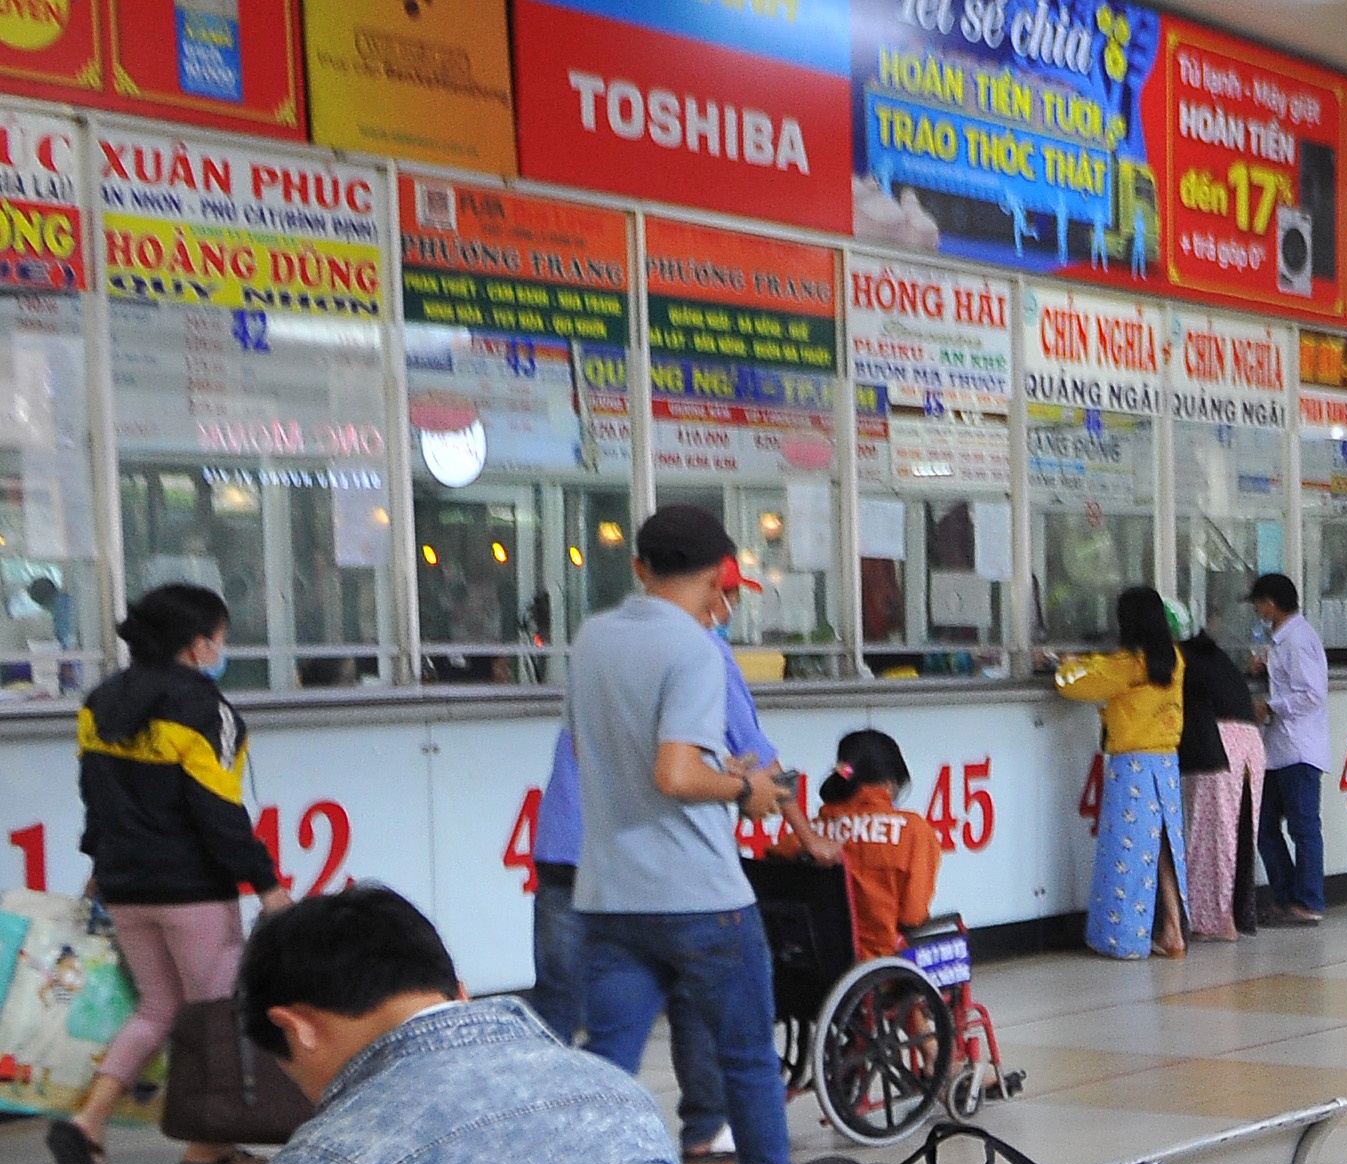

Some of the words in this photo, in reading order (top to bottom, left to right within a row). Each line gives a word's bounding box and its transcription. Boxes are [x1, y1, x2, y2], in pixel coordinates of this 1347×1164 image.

[568, 69, 811, 176] TOSHIBA
[875, 103, 958, 163] TRAO
[99, 138, 235, 196] XUÂN
[250, 156, 374, 216] PHÚC
[105, 222, 256, 281] HOÀNG
[270, 240, 380, 295] DŨNG
[529, 247, 625, 288] TRANG
[752, 271, 831, 306] TRANG
[852, 265, 944, 319] HỒNG
[1023, 366, 1102, 406] QUẢNG
[925, 755, 995, 853] 45
